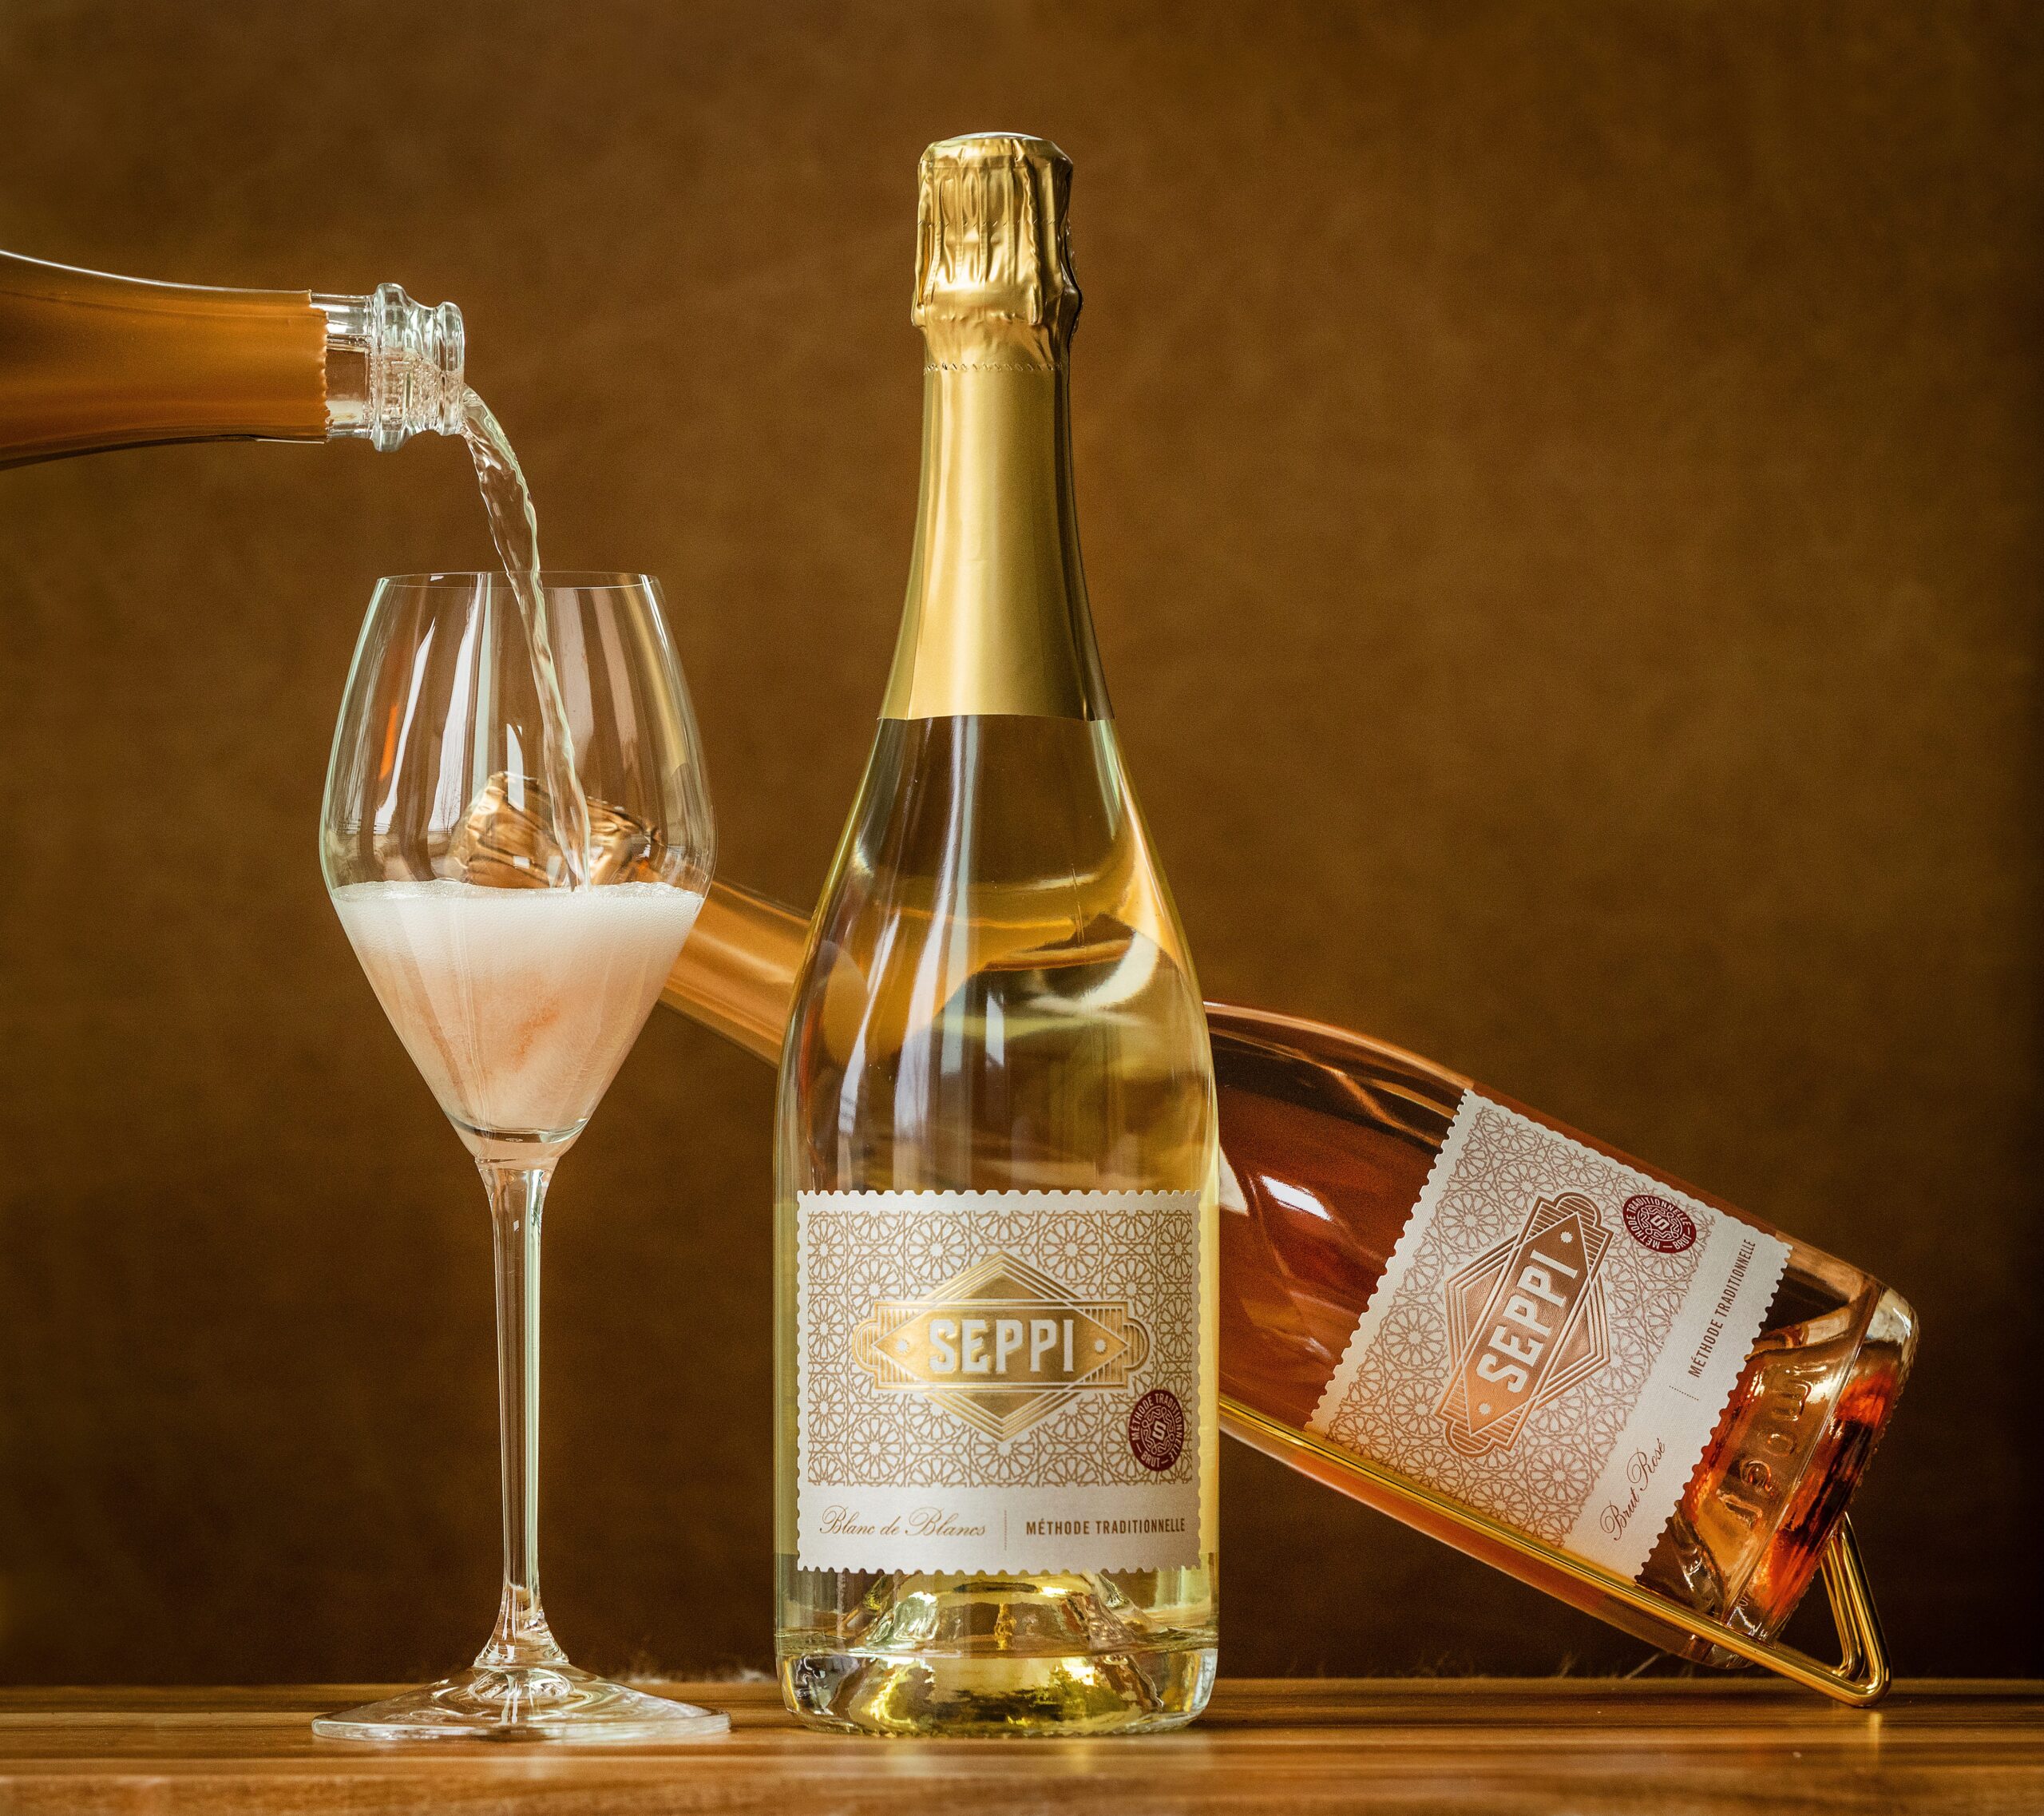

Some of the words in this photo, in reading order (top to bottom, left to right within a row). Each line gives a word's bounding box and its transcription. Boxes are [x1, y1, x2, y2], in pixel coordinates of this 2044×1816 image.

[1626, 1197, 1692, 1227] TRADITIONNELLE
[1650, 1215, 1670, 1230] S
[1626, 1215, 1661, 1250] MÉTHODE
[1672, 1233, 1692, 1250] BRUT
[1476, 1249, 1578, 1393] SEPPI
[1688, 1318, 1723, 1378] MÉTHODE
[1715, 1239, 1756, 1318] TRADITIONNELLE
[929, 1318, 1074, 1373] SEPPI
[1130, 1396, 1154, 1441] MÉTHODE
[1155, 1393, 1182, 1461] TRADITIONNELLE
[1152, 1421, 1167, 1441] S
[1141, 1451, 1160, 1468] BRUT
[1600, 1487, 1640, 1541] Brut
[1626, 1437, 1666, 1492] Rosé
[819, 1505, 875, 1536] Blanc
[880, 1515, 900, 1536] de
[905, 1506, 986, 1536] Blancs
[1026, 1518, 1090, 1535] MÉTHODE
[1095, 1517, 1186, 1534] TRADITIONNELLE
